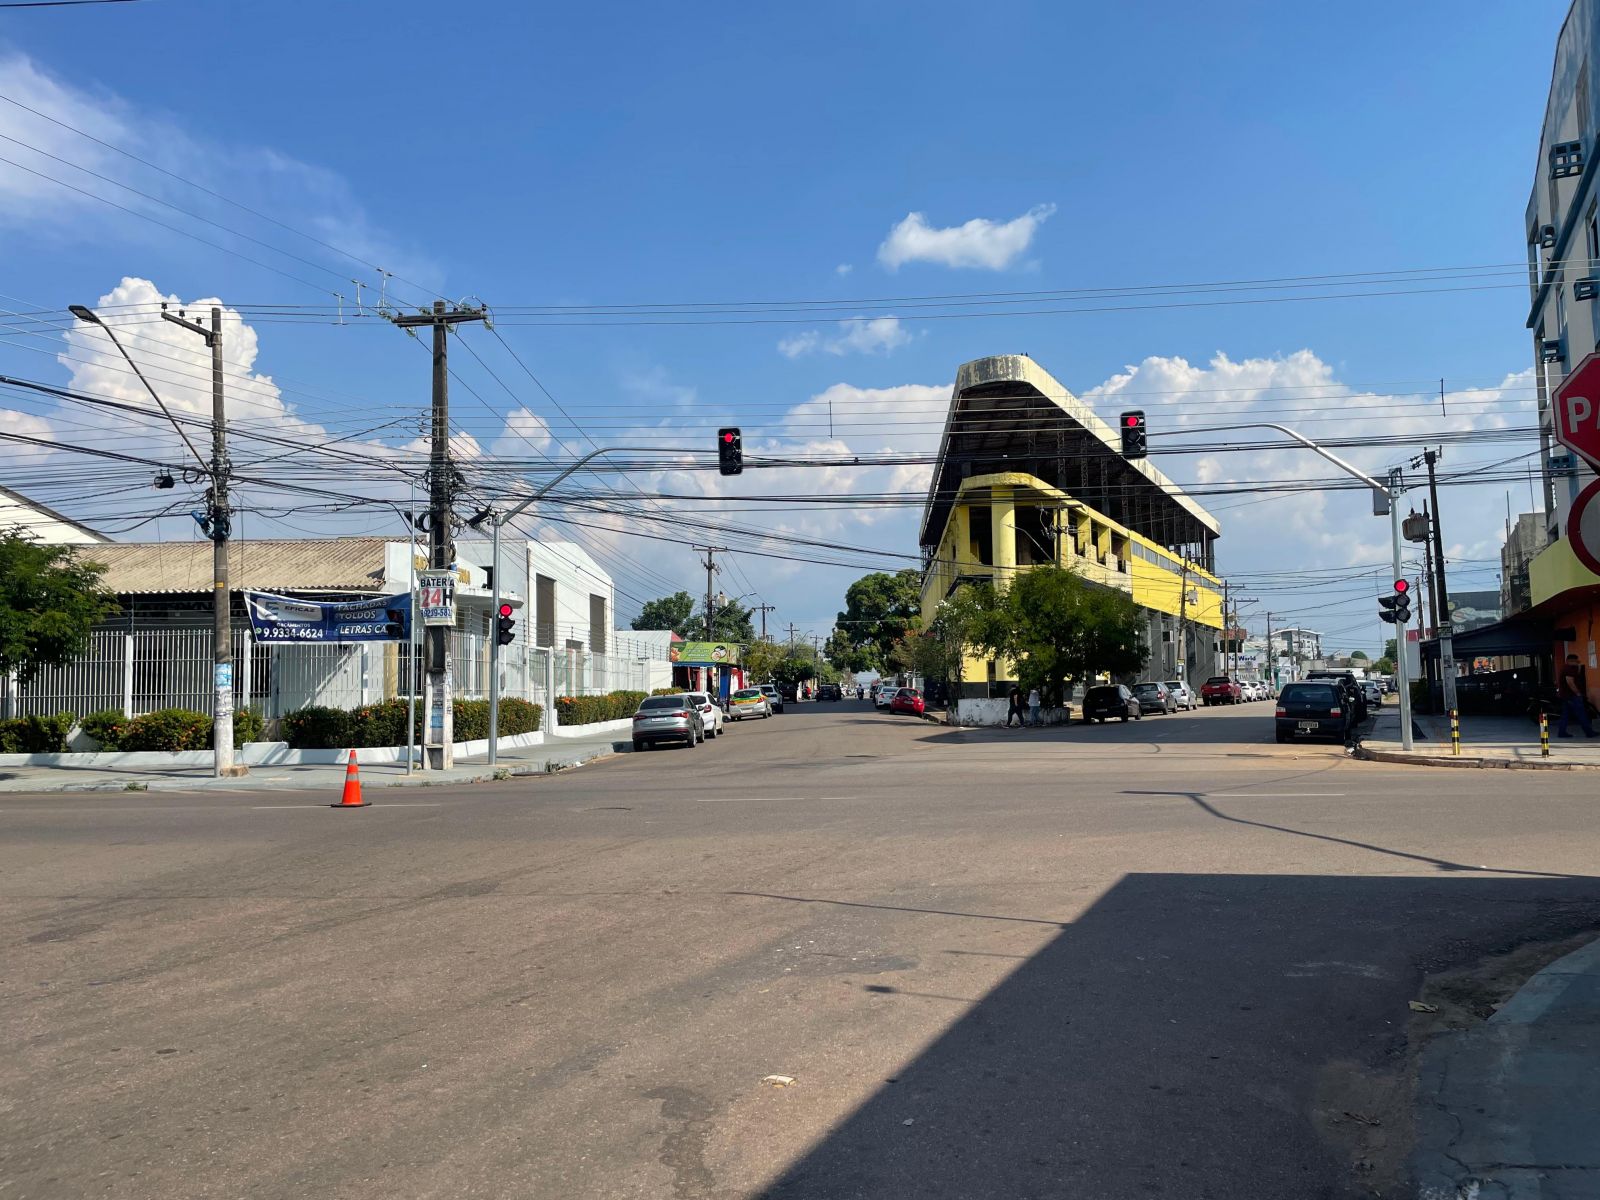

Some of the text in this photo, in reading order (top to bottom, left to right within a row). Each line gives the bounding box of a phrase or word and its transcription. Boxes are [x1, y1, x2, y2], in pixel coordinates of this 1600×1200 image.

[1567, 396, 1600, 433] P
[421, 587, 454, 609] 24H
[284, 605, 317, 613] EFICAZ
[337, 600, 389, 611] FACHADAS
[340, 610, 376, 620] TOLDOS
[263, 627, 324, 639] 9.9334-6624
[340, 624, 389, 635] LETRAS CA
